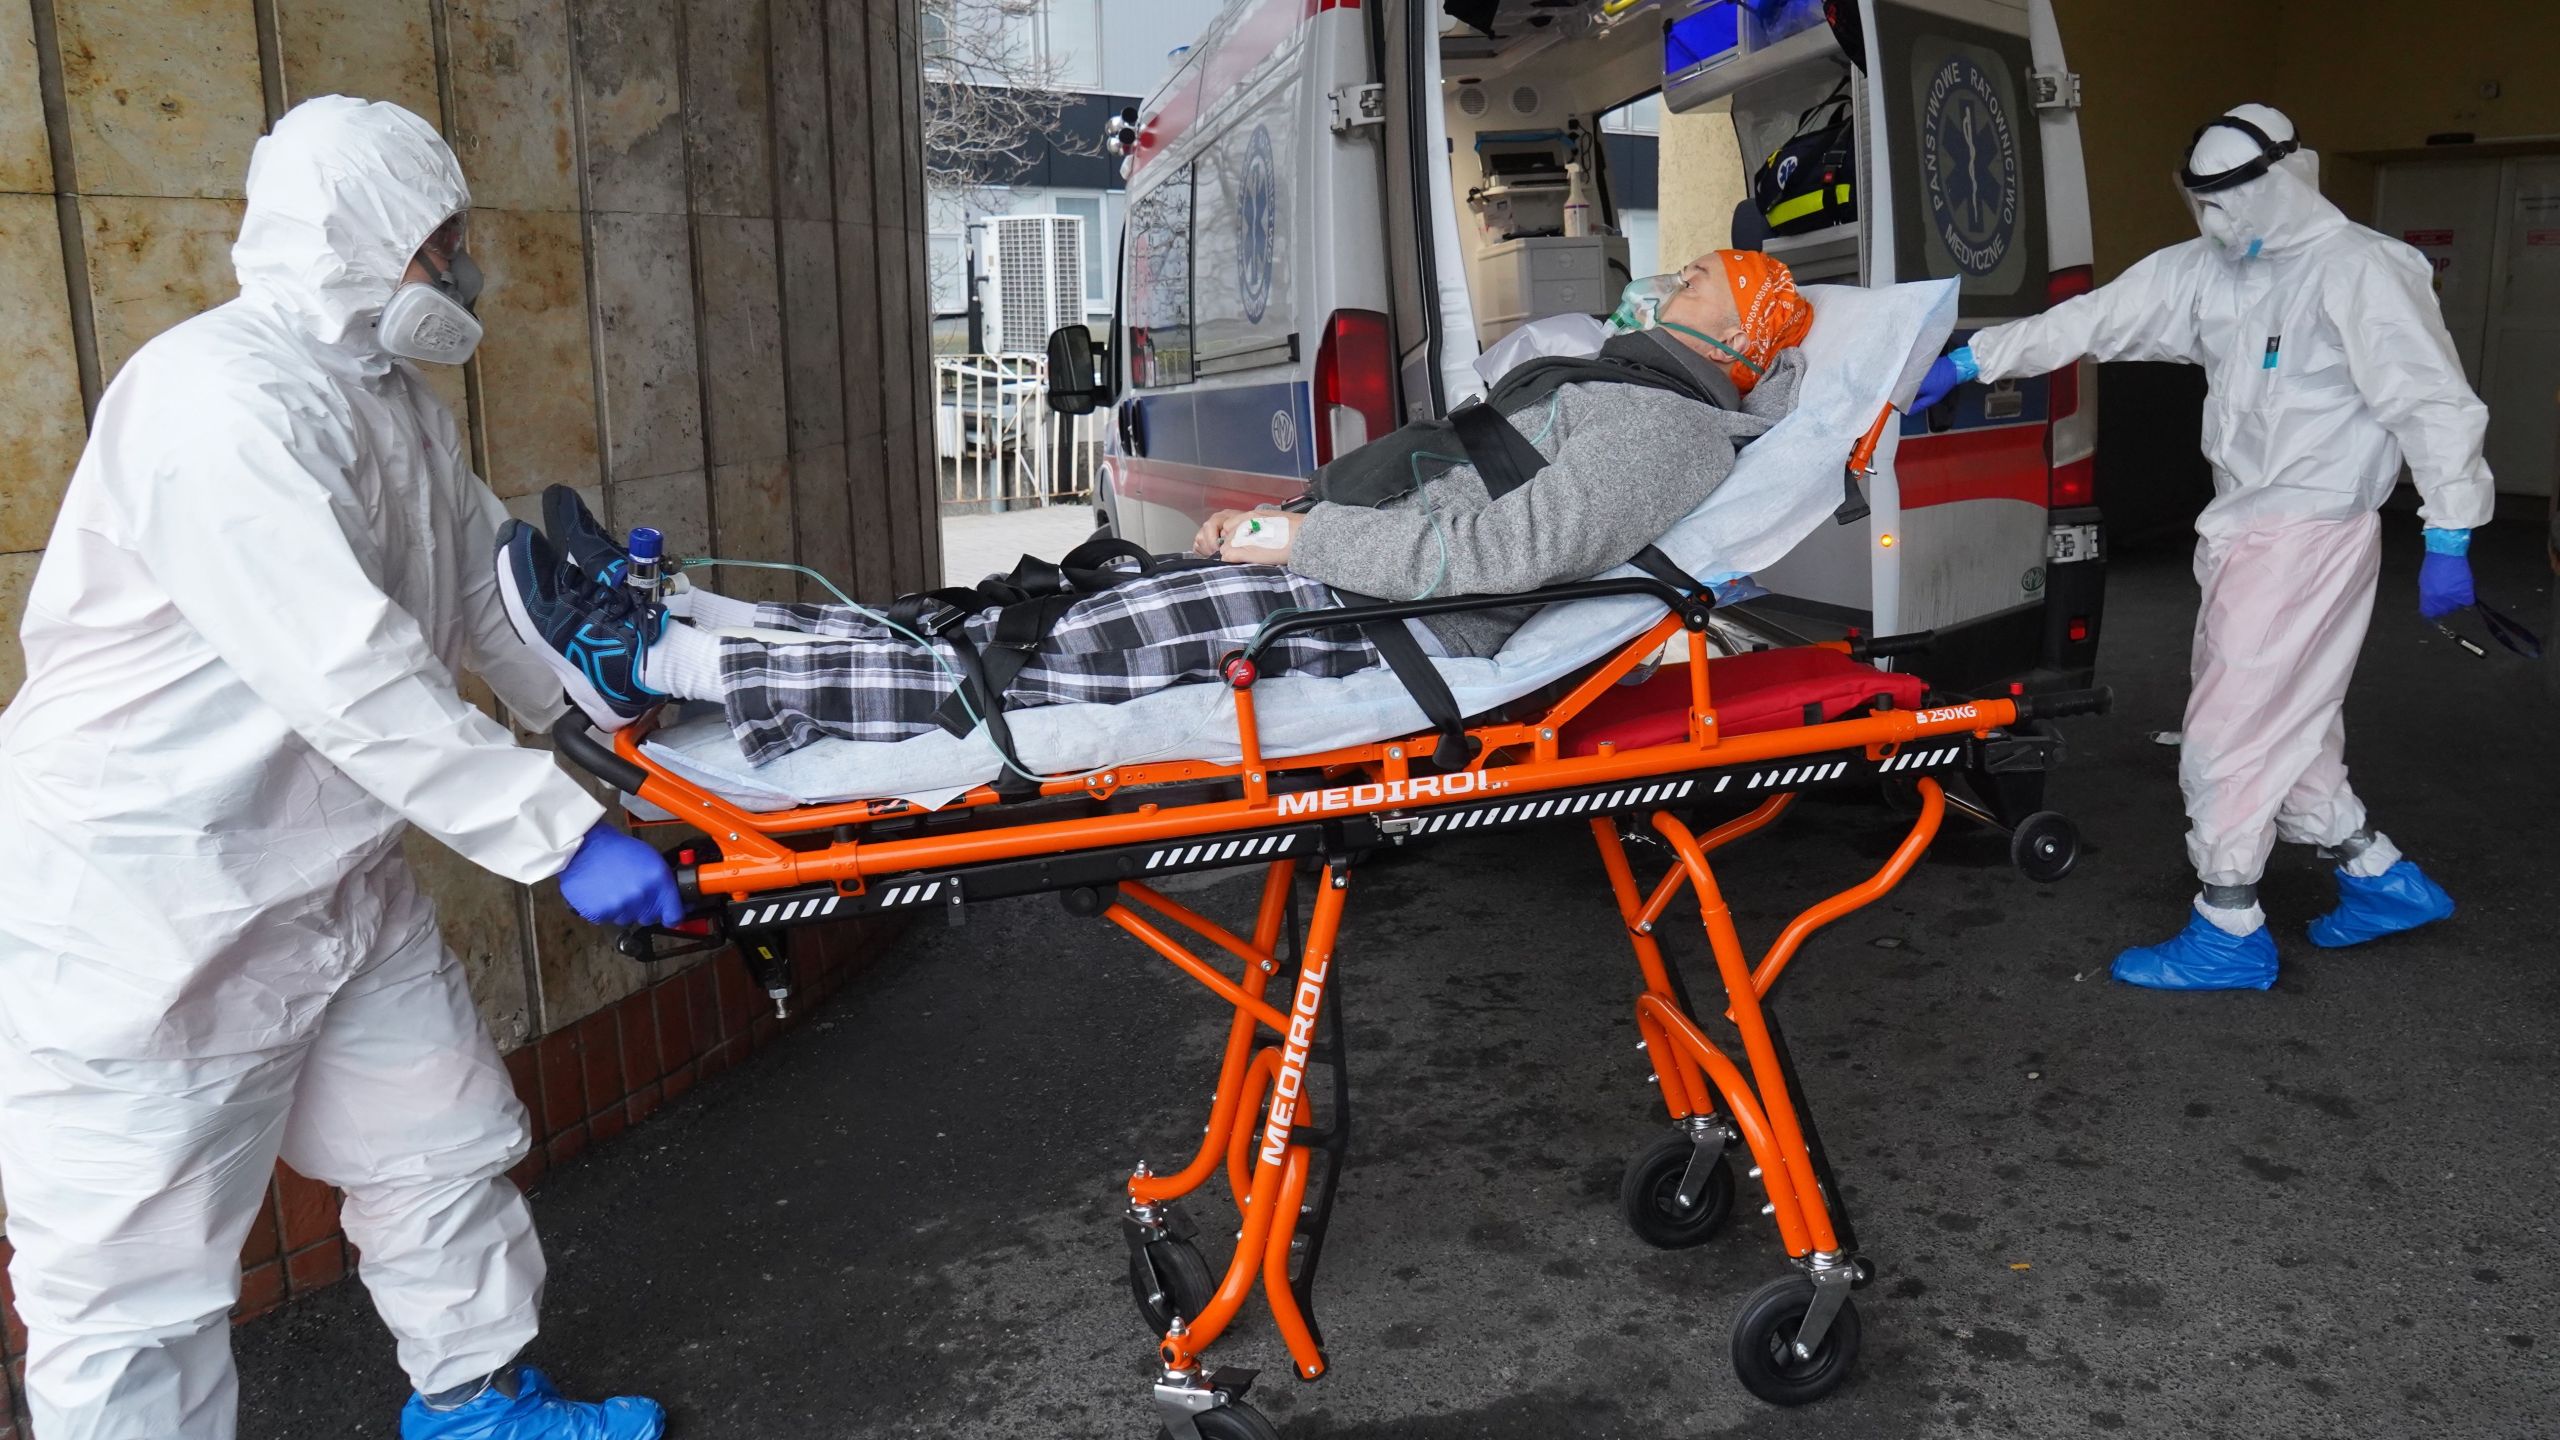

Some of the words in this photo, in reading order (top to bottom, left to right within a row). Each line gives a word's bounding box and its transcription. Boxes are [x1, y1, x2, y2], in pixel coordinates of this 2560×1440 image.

[1925, 62, 1962, 212] PAŃSTWOWE
[1970, 67, 2017, 225] RATOWNICTWO
[1945, 223, 2005, 271] MEDYCZNE
[1277, 769, 1502, 816] MEDIROL
[1261, 961, 1328, 1167] MEDIROL
